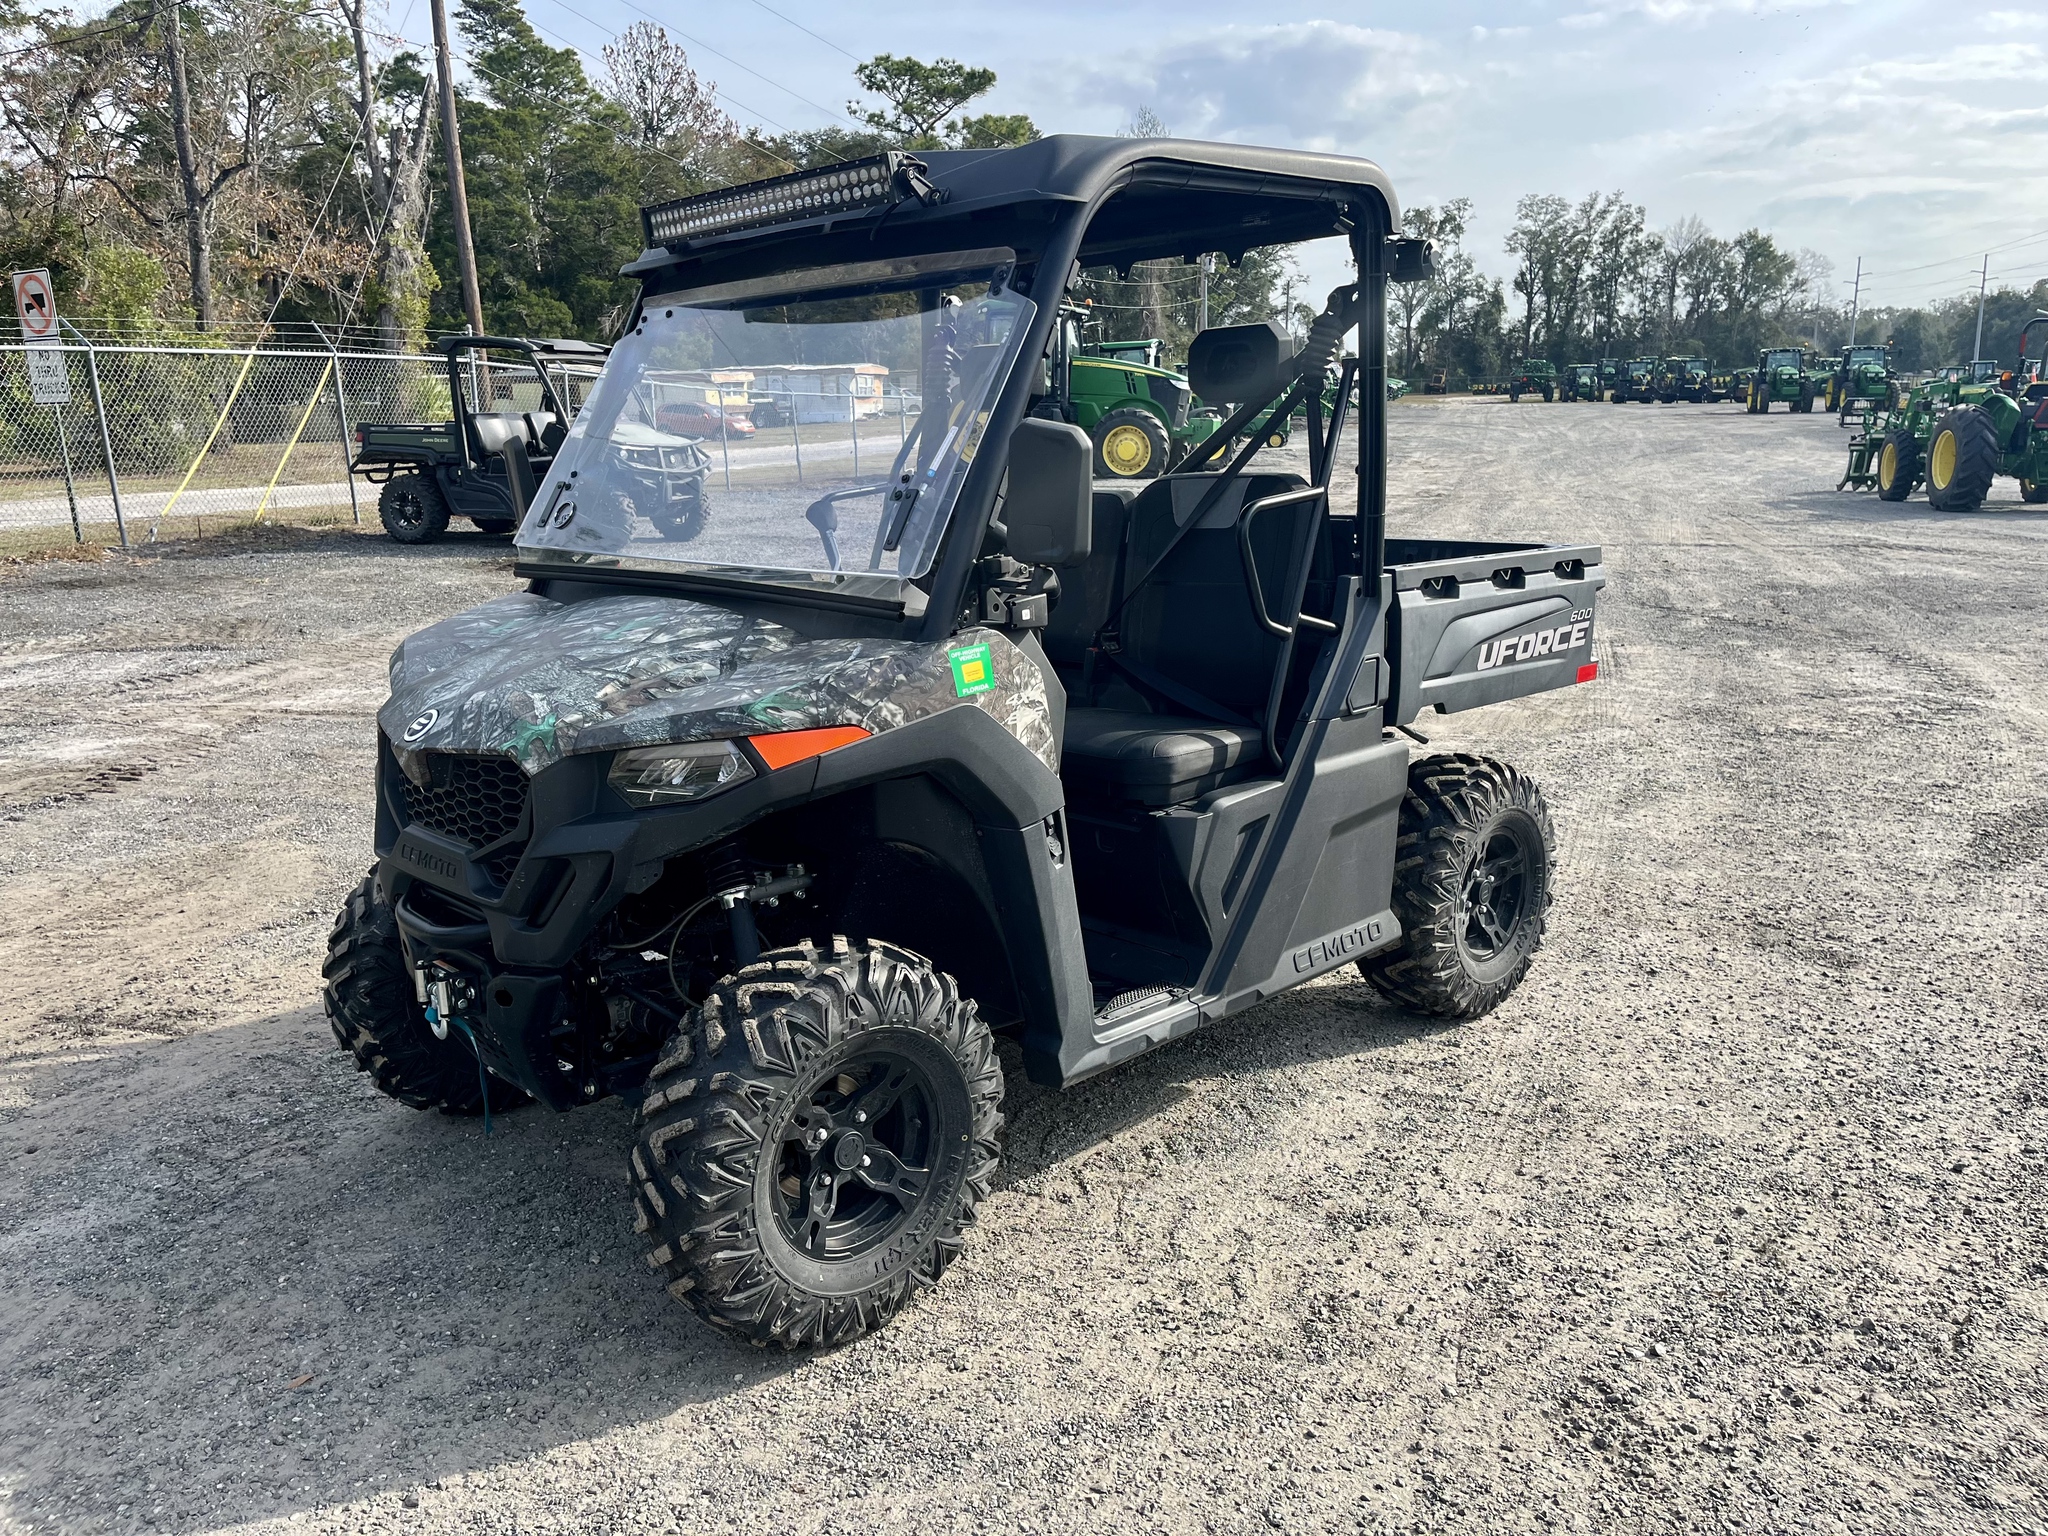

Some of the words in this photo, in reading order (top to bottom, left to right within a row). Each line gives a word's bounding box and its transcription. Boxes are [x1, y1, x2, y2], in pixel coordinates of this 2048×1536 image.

[36, 365, 59, 378] THRU
[33, 381, 67, 395] TRUCKS
[1570, 607, 1593, 622] 600
[950, 646, 986, 659] OFF-HIGHWAY
[1477, 621, 1591, 671] UFORCE
[958, 653, 981, 662] VEHICLE
[962, 683, 990, 695] FLORIDA
[401, 843, 457, 880] CFMOTO
[1292, 918, 1383, 973] CFMOTO
